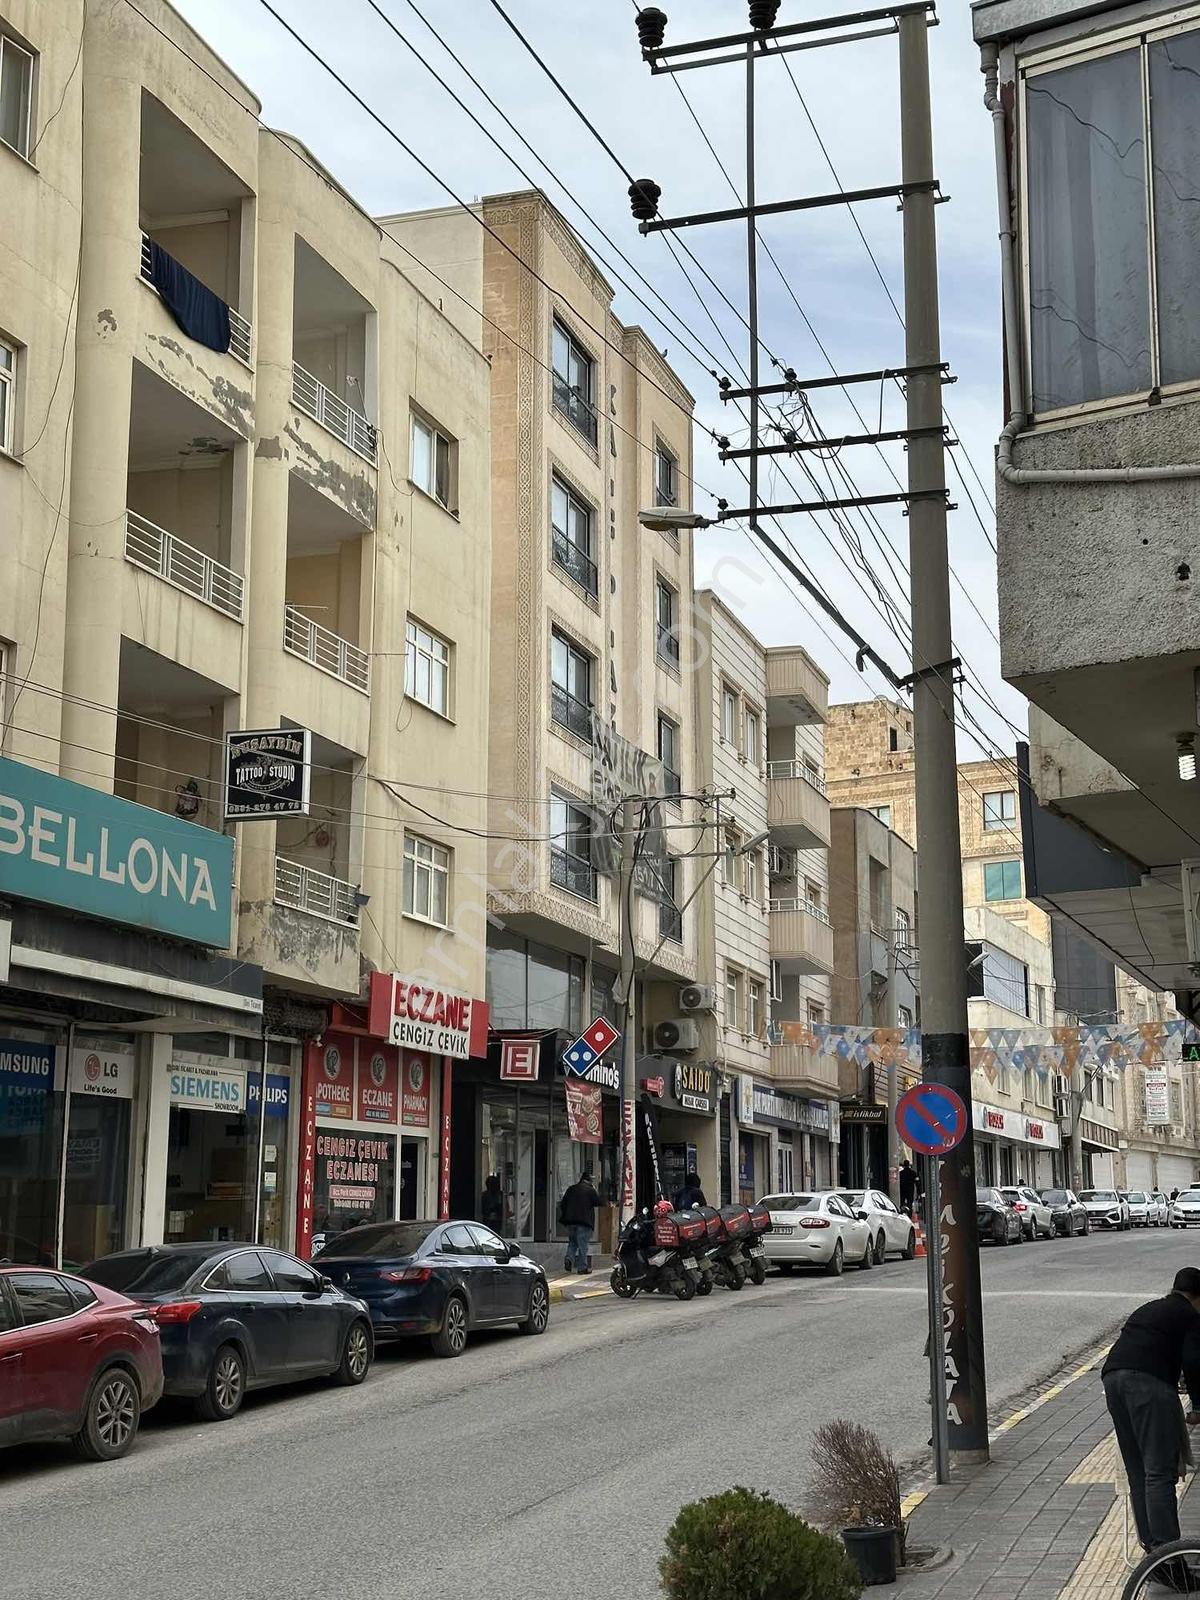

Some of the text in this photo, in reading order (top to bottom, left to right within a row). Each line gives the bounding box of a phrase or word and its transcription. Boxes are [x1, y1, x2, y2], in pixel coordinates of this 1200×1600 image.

[235, 765, 295, 785] TATTOO STUDIO
[0, 794, 217, 912] BELLONA
[393, 979, 470, 1032] ECZANE
[393, 1021, 434, 1047] CENGİZ
[0, 1051, 50, 1076] MSUNG
[103, 1061, 119, 1078] LG
[585, 1058, 620, 1090] mino's
[84, 1083, 117, 1095] Life's Good
[170, 1075, 240, 1101] SIEMENS
[682, 1064, 710, 1094] SAIDO
[248, 1085, 288, 1104] PHLIPS
[362, 1088, 393, 1107] ECZANE
[316, 1135, 389, 1161] CENGİZ ÇEVİK
[303, 1096, 313, 1233] ECZANE
[326, 1160, 379, 1182] ECZANESİ
